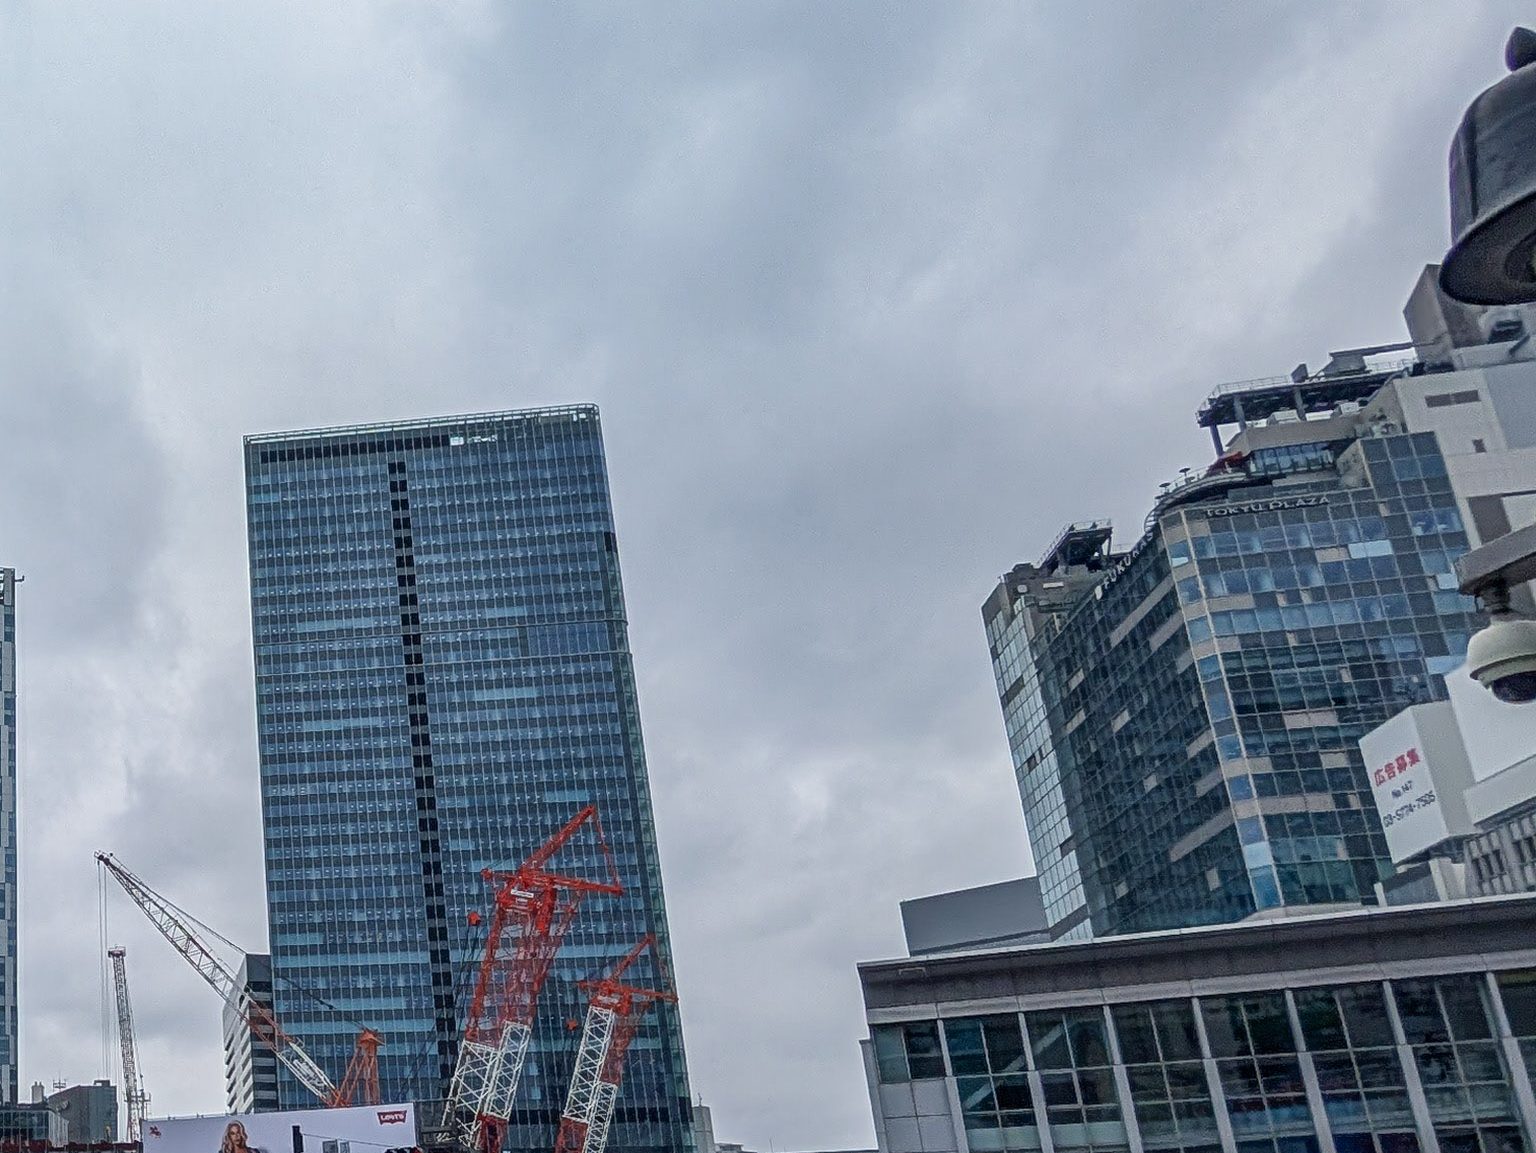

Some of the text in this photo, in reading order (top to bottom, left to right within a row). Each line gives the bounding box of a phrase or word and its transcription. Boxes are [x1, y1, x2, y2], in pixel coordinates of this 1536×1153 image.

[1205, 496, 1331, 518] TOKYU PLAZA
[1374, 747, 1421, 787] 広告募集
